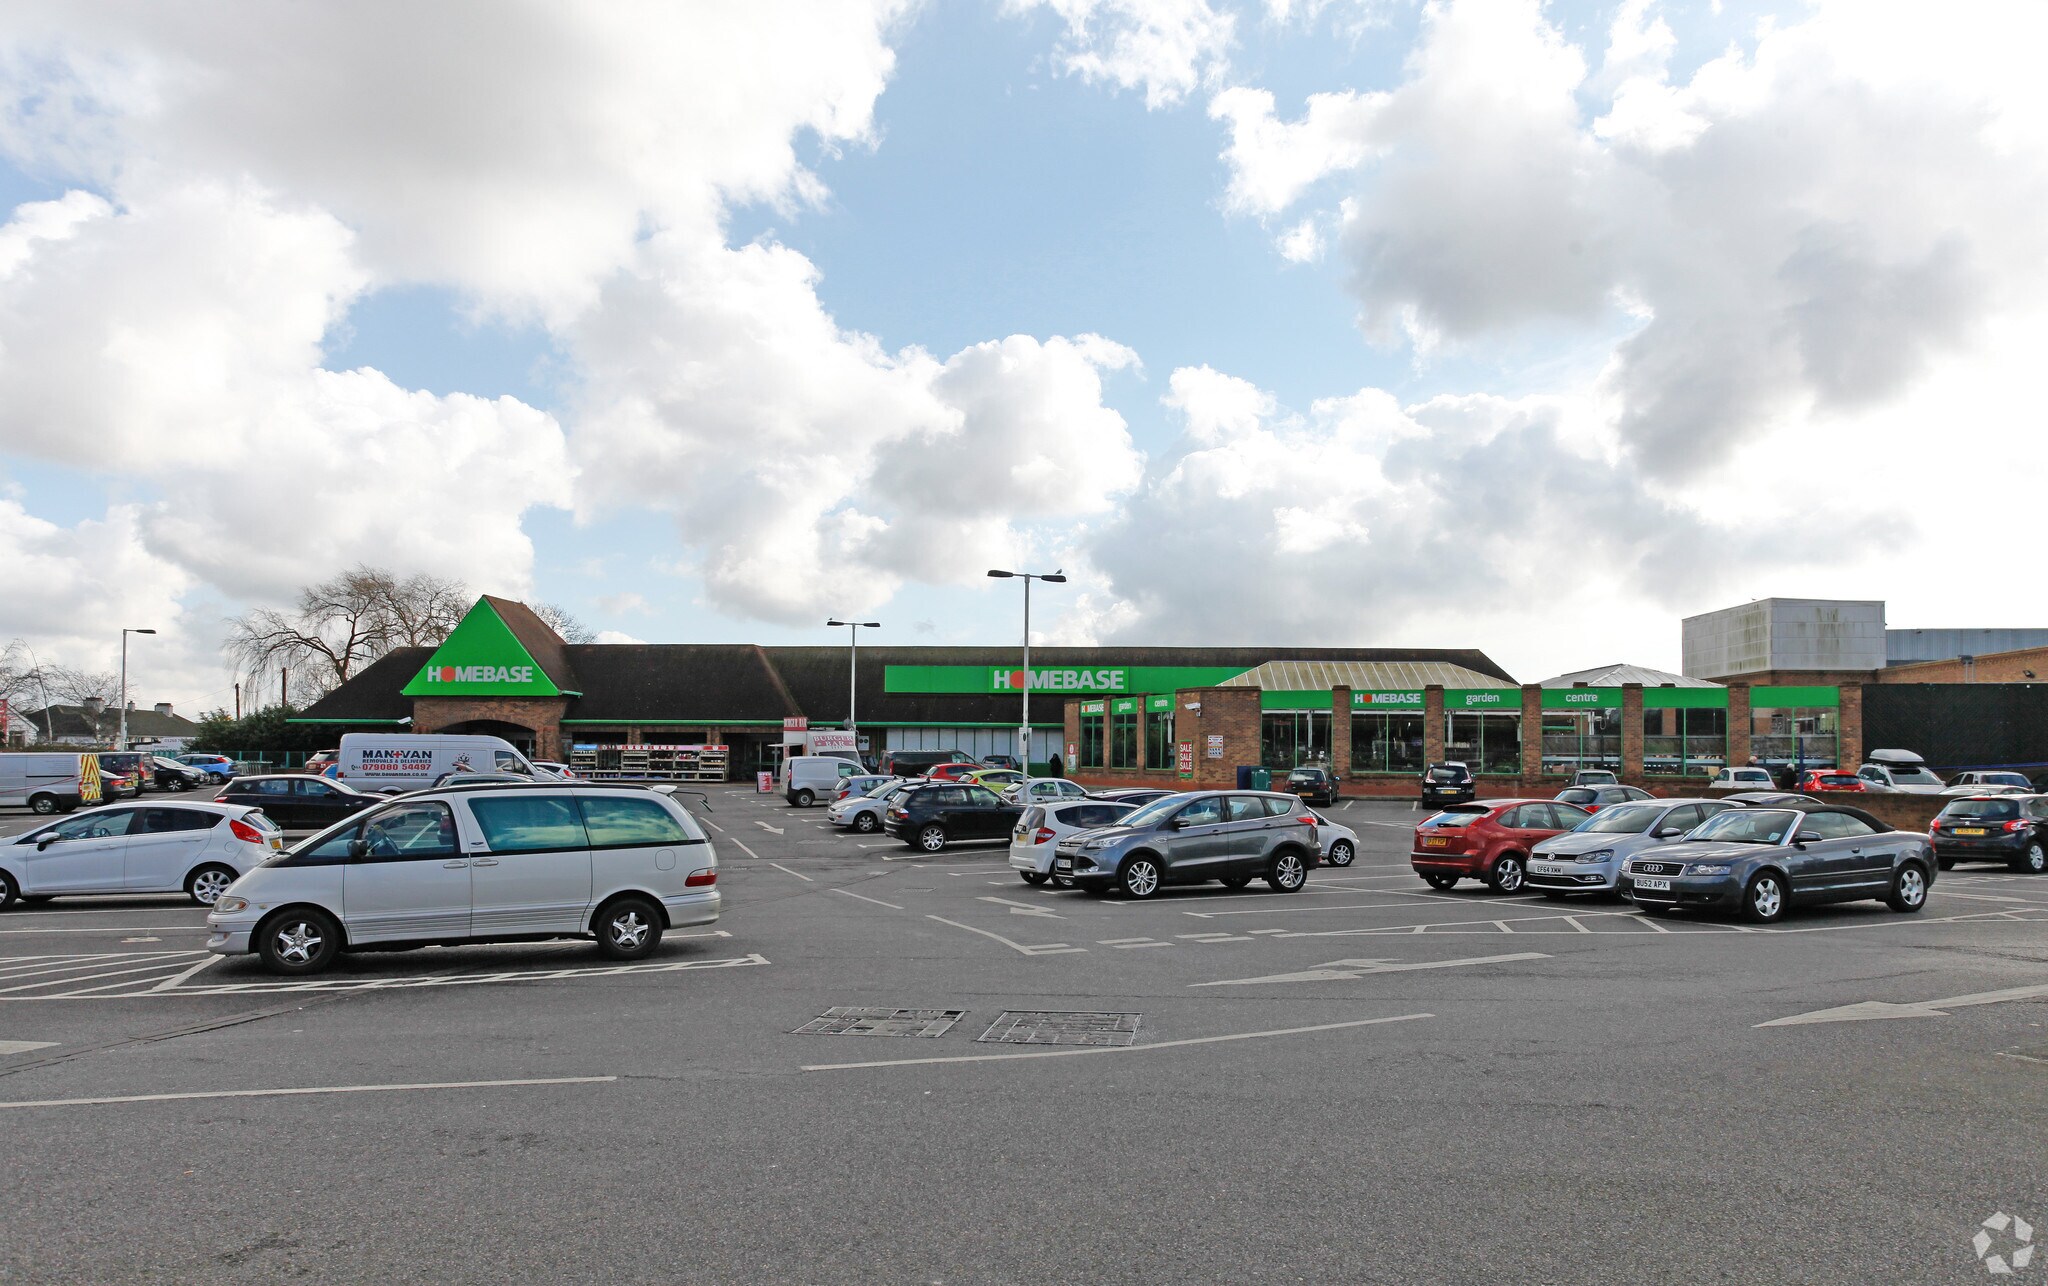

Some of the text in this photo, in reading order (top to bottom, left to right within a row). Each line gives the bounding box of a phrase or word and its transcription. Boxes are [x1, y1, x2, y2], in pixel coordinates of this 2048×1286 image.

[427, 666, 533, 683] HOMEBASE
[993, 670, 1124, 690] HOMEBASE
[1354, 692, 1598, 705] HOMEBASE garden centre
[1118, 701, 1132, 712] garden
[1154, 699, 1168, 708] centre
[1179, 744, 1192, 752] SALE
[1179, 753, 1192, 761] SALE
[1179, 761, 1192, 770] SALE
[1537, 865, 1550, 873] EF64
[1637, 879, 1667, 889] BU52 APX
